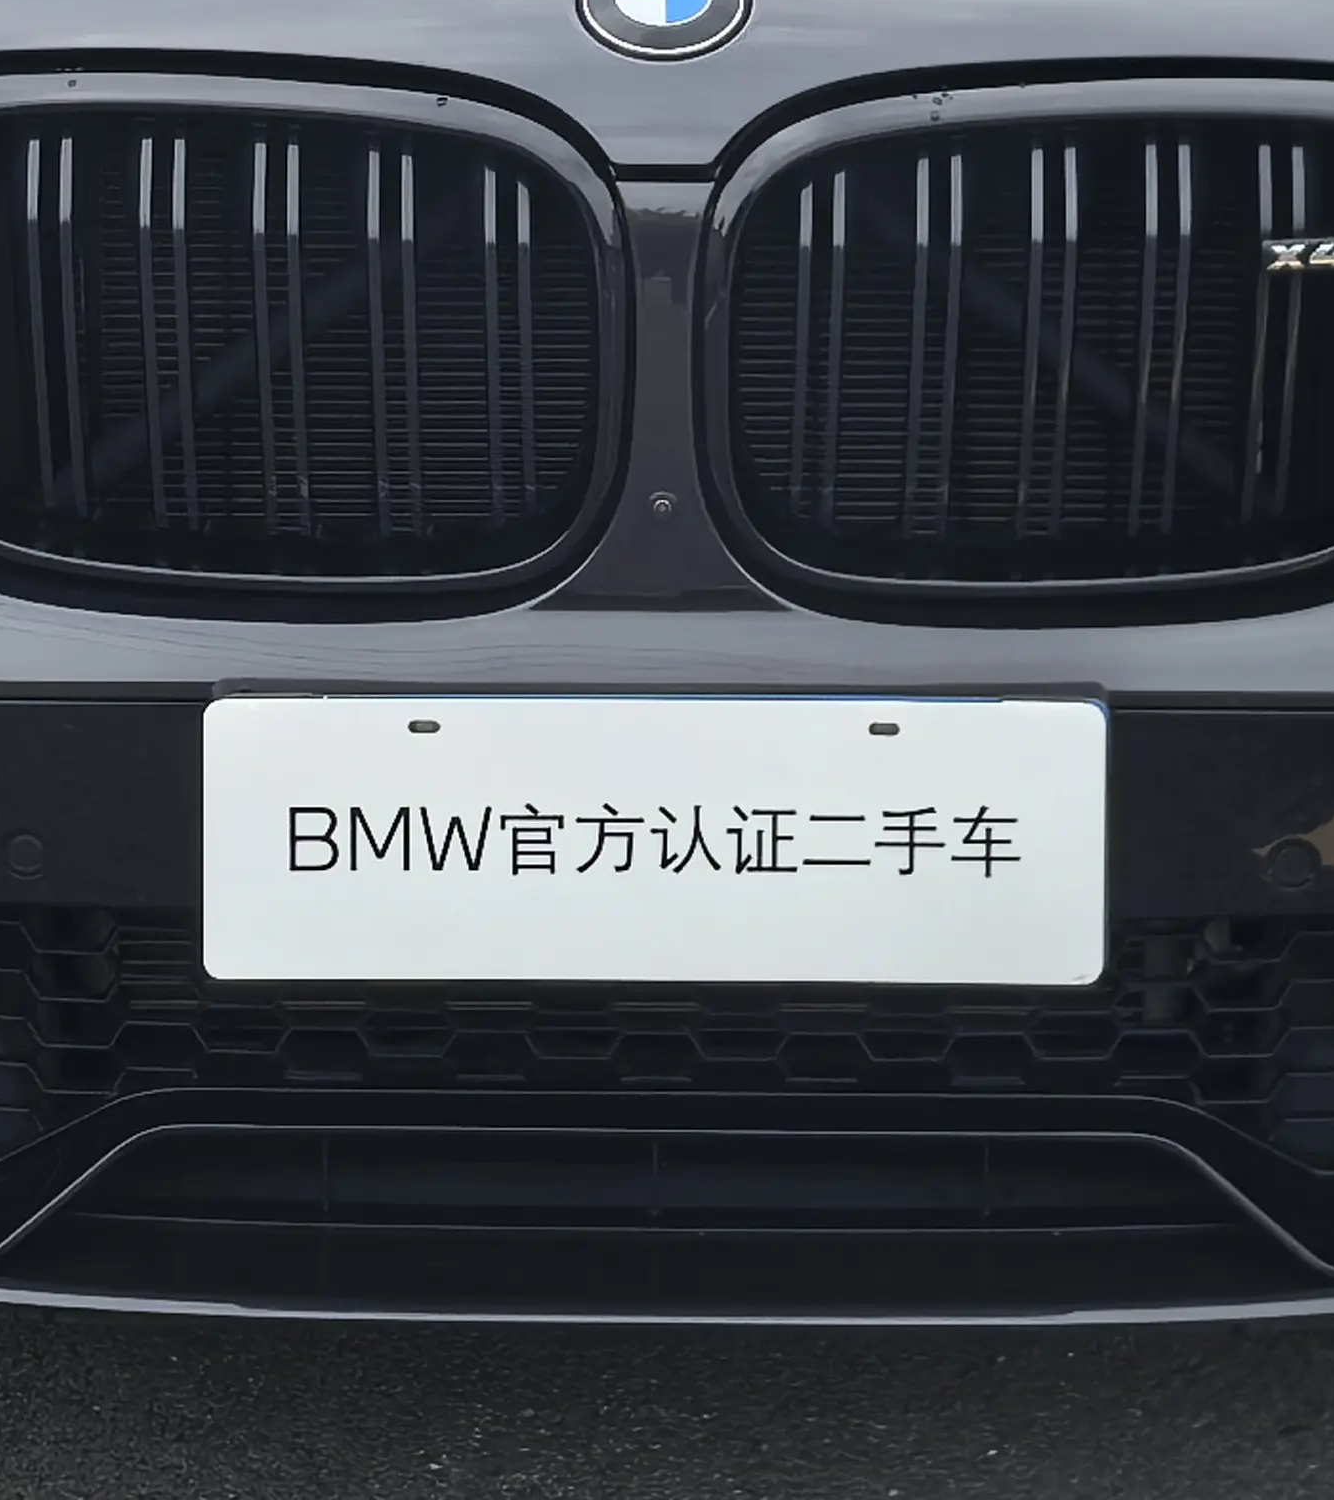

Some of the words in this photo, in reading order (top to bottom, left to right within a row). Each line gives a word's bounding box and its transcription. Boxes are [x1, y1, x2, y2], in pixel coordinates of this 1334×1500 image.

[289, 803, 1021, 878] BMW官方认证二手车
